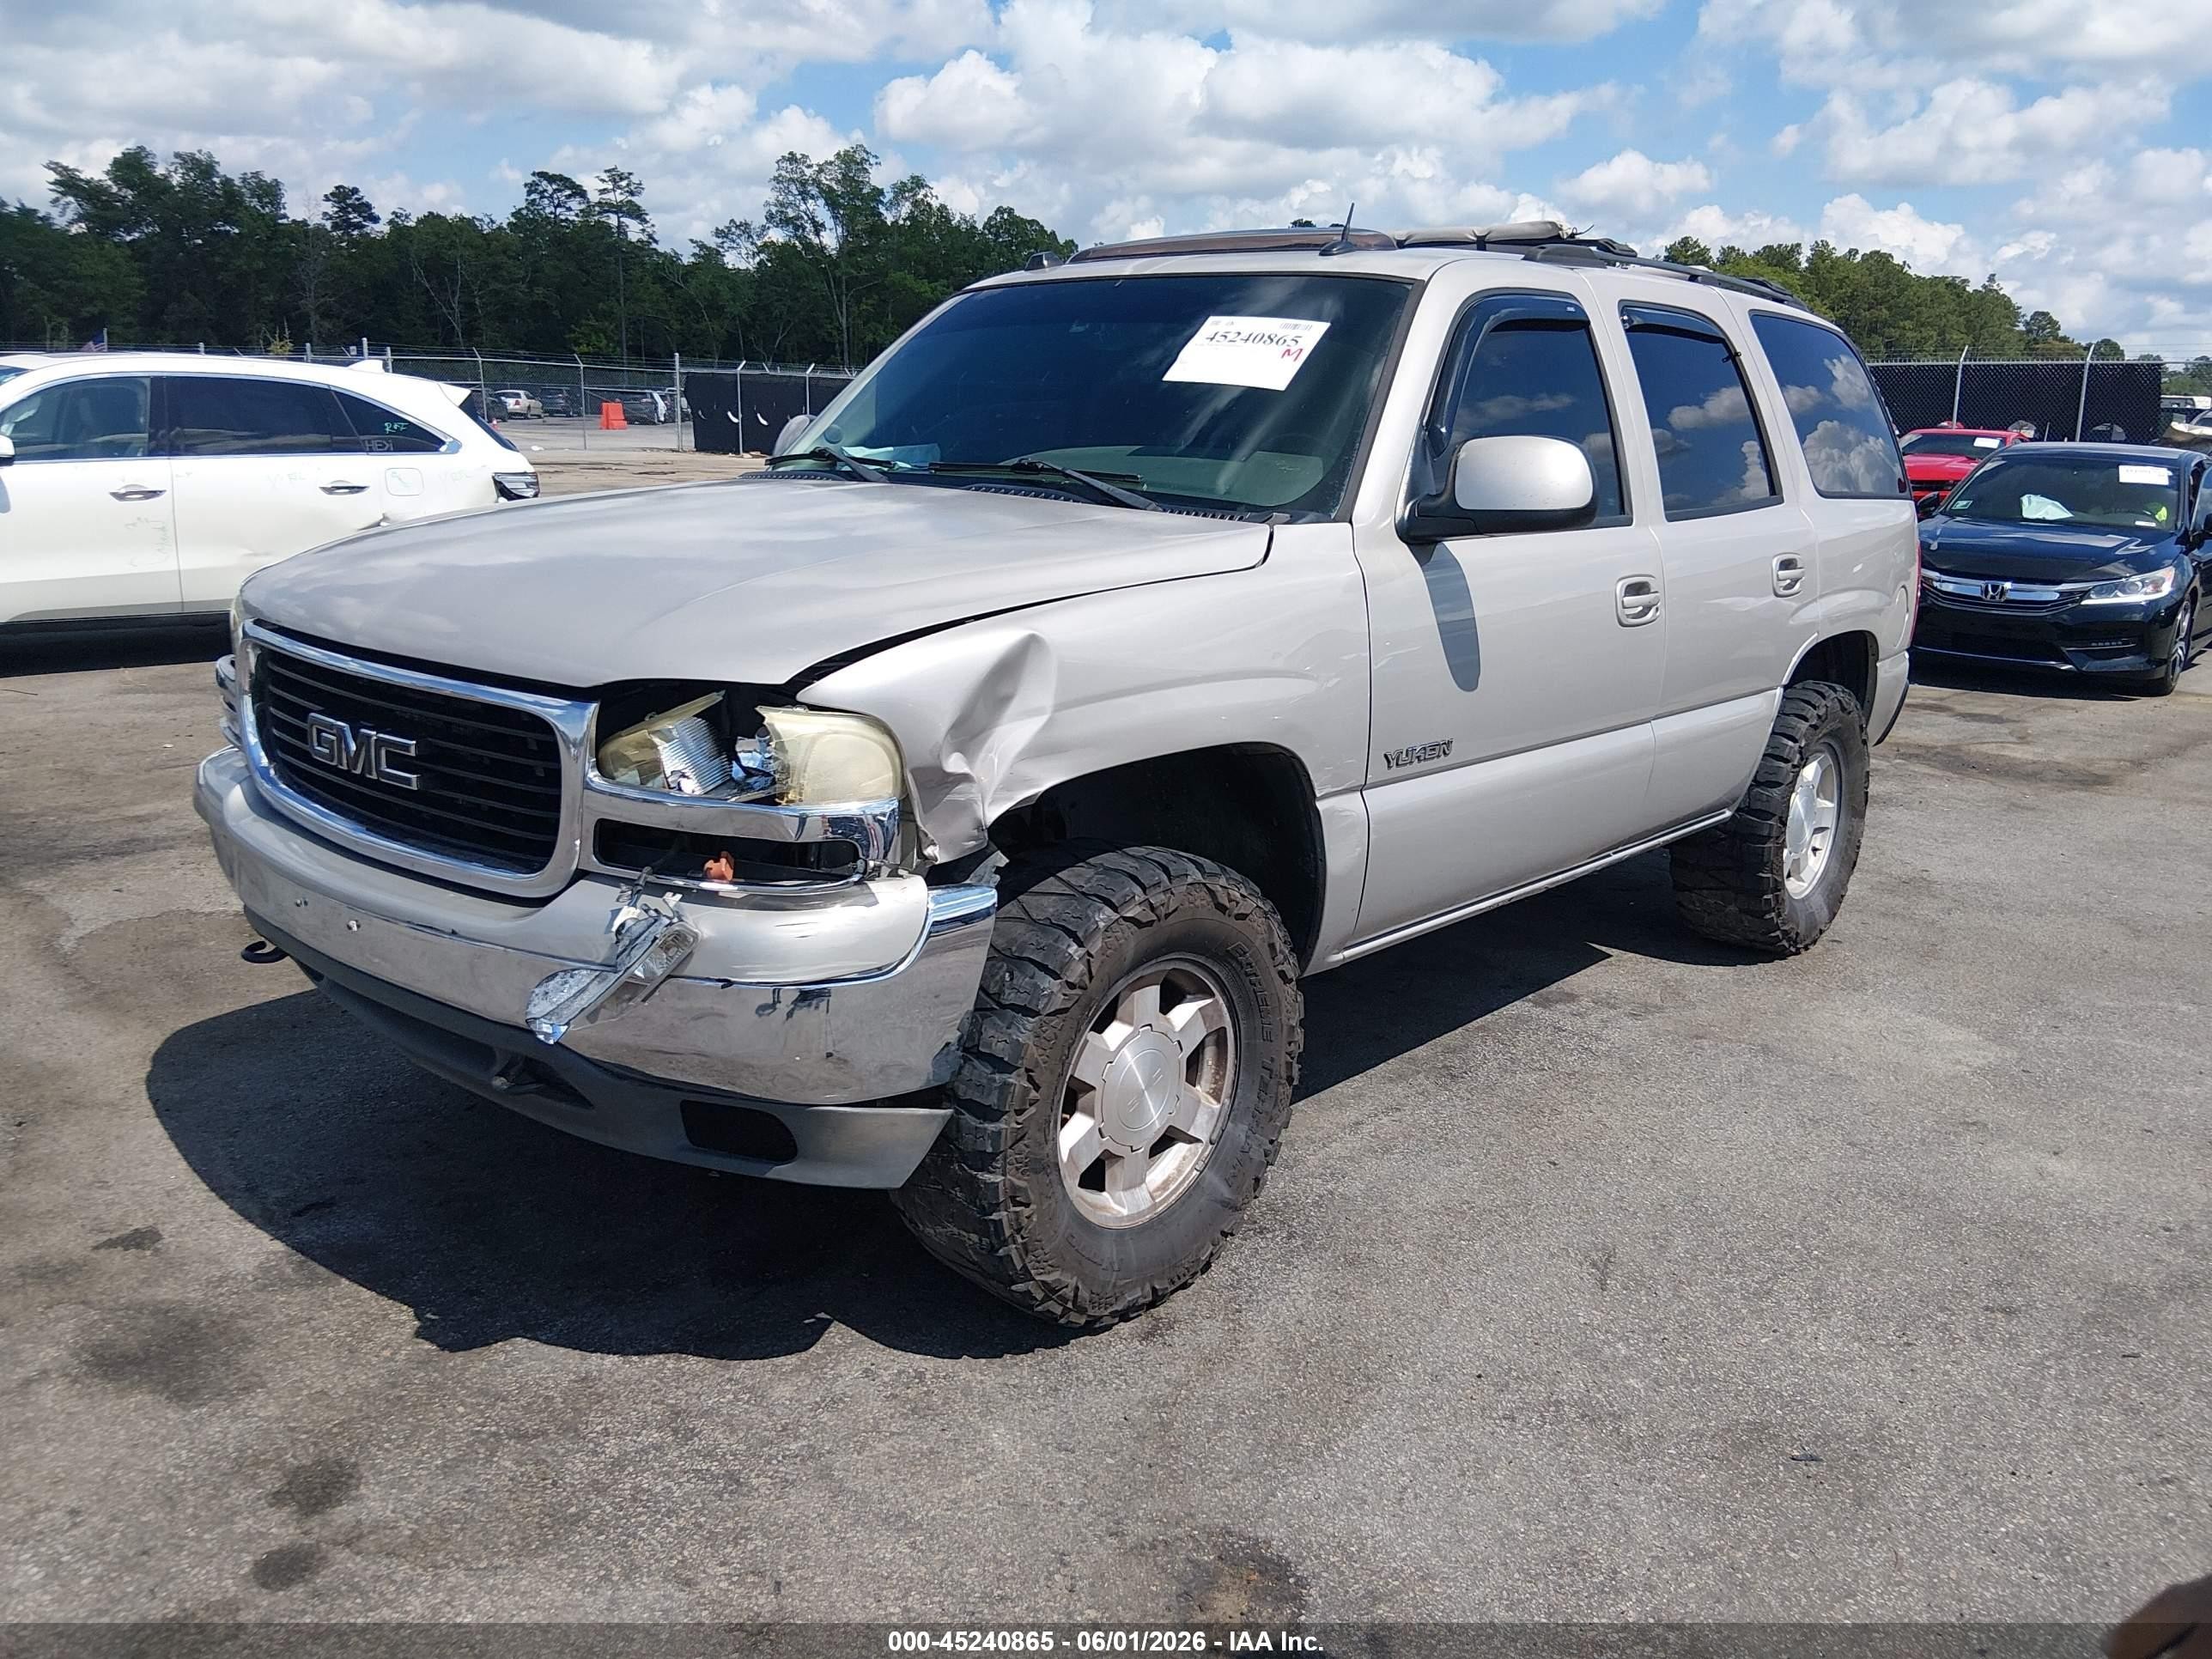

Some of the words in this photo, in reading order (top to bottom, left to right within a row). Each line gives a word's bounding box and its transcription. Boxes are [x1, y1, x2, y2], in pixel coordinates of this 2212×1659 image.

[1205, 331, 1303, 348] 45240865
[1280, 348, 1304, 362] M
[307, 713, 421, 790] GMC
